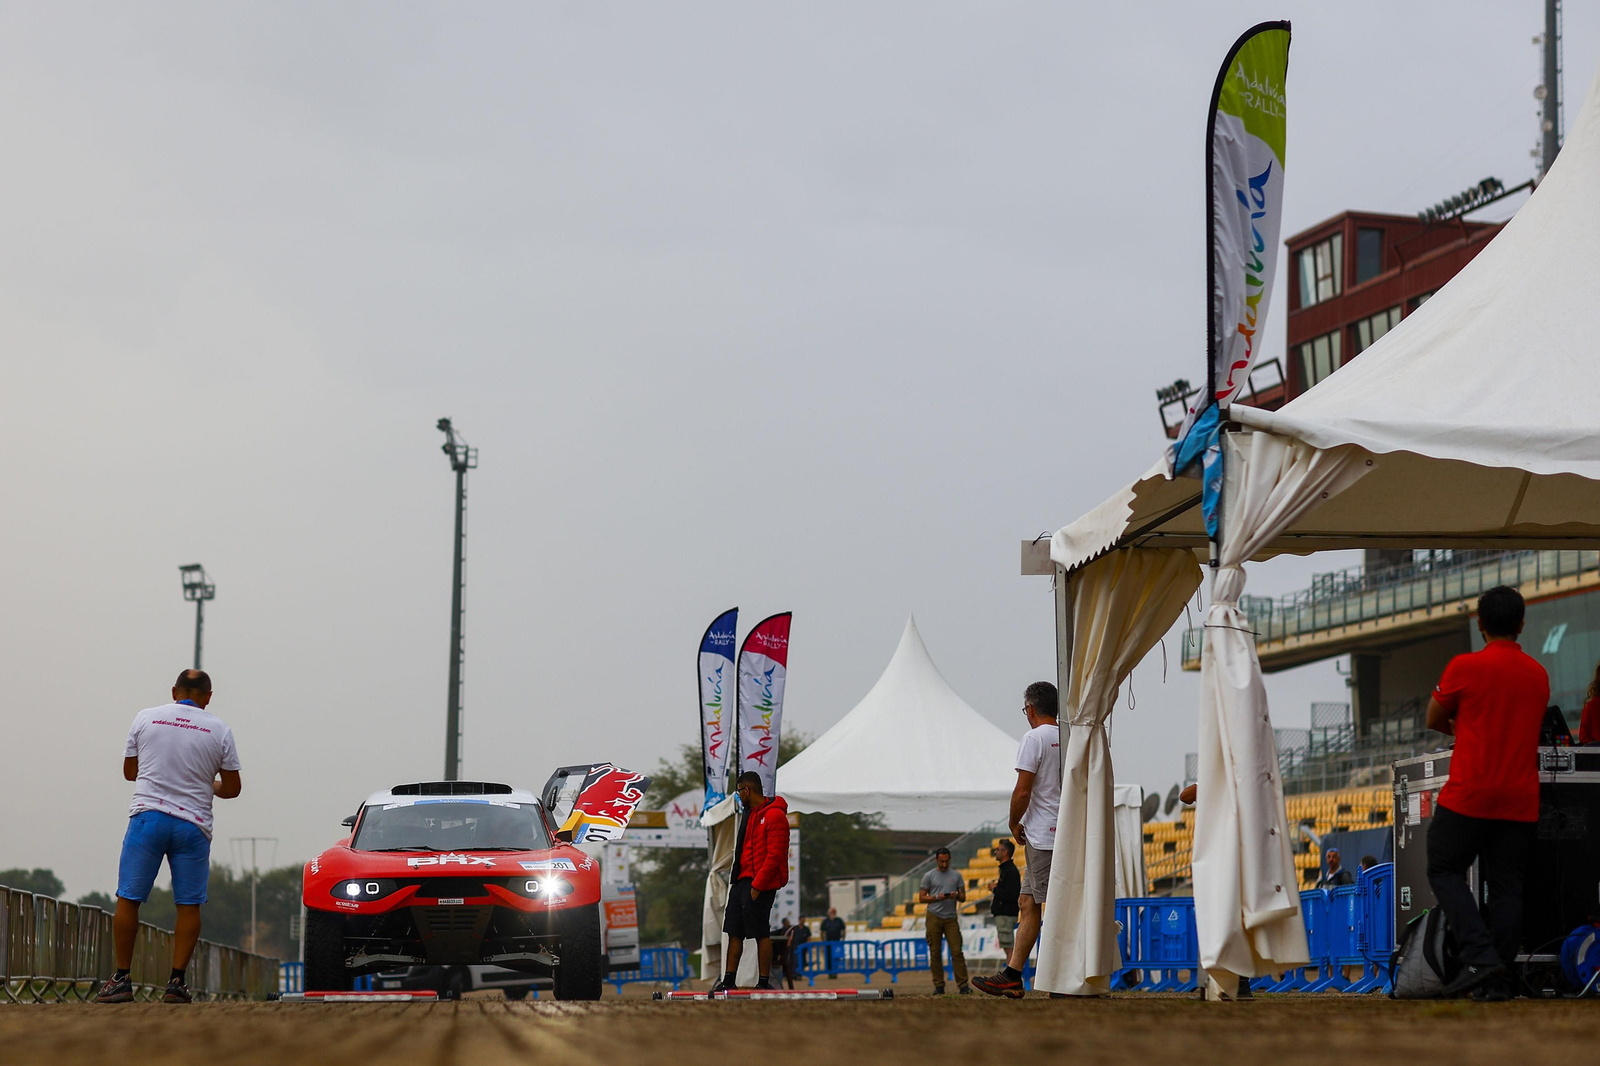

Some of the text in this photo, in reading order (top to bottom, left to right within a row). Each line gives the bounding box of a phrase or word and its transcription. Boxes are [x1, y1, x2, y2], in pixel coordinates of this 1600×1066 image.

[1244, 91, 1279, 117] RALLY
[1215, 158, 1273, 400] ndalucía
[763, 640, 782, 650] RALLY
[175, 716, 191, 724] www
[705, 660, 725, 760] Andalucía
[746, 664, 776, 768] Andalucía
[551, 861, 570, 870] 201
